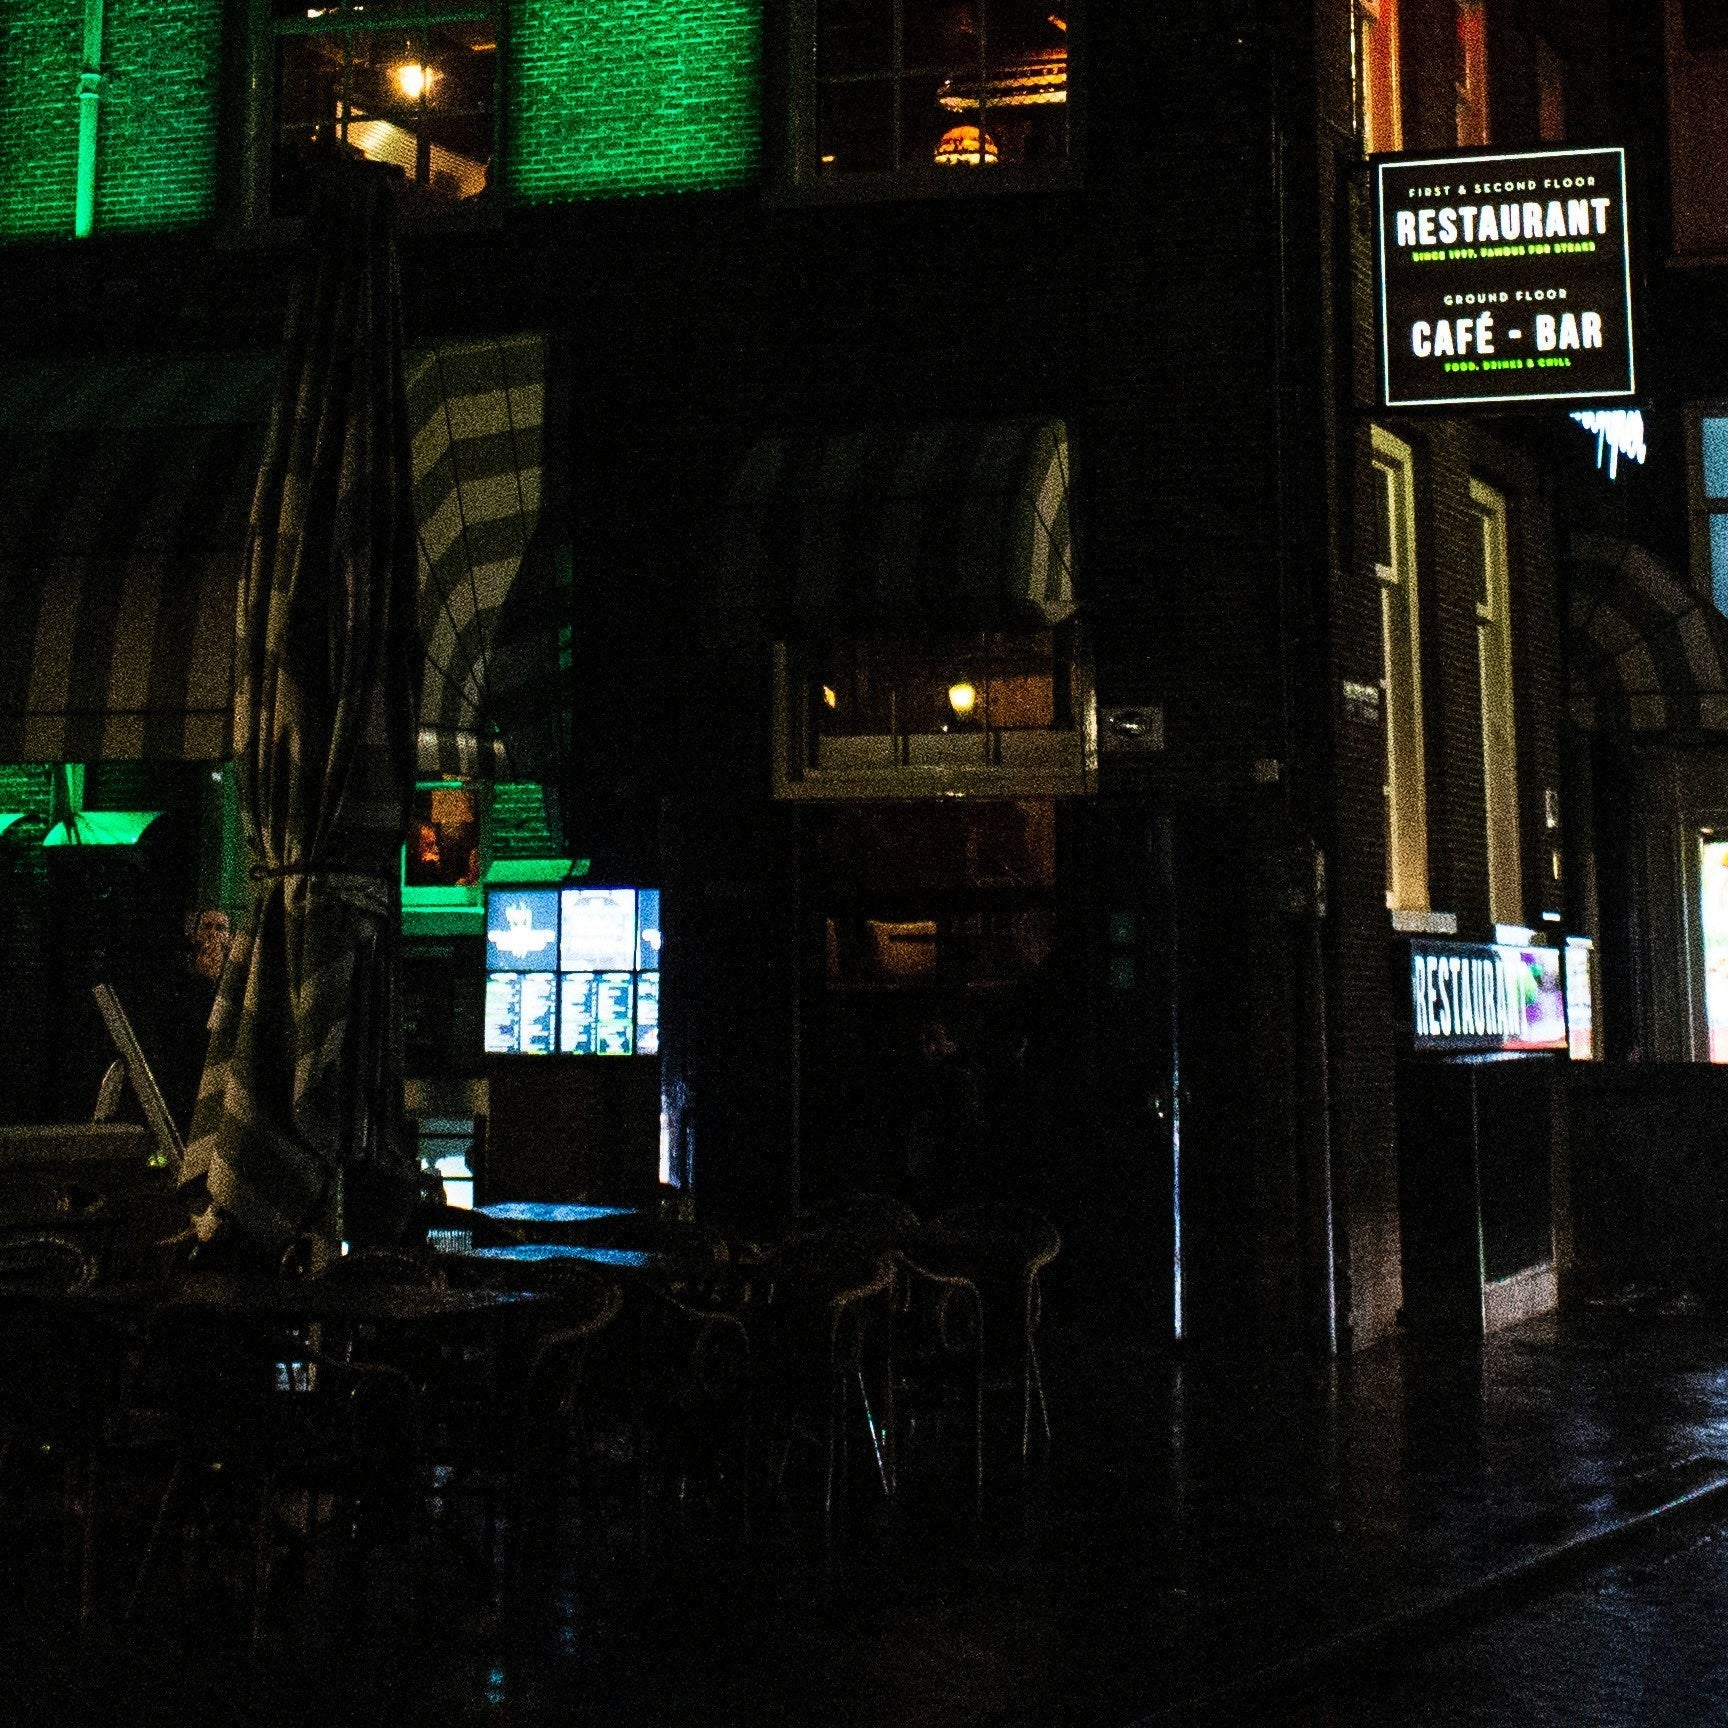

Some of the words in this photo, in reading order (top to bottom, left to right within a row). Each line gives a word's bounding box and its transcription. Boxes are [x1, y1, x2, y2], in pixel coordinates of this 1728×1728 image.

[1408, 185, 1450, 198] FIRST
[1458, 184, 1467, 196] &
[1474, 179, 1537, 194] SECOND
[1544, 176, 1596, 189] FLOOR
[1396, 197, 1611, 247] RESTAURANT
[1443, 291, 1509, 306] GROUND
[1515, 288, 1568, 301] FLOOR
[1411, 310, 1496, 358] CAFÉ
[1535, 310, 1603, 352] BAR
